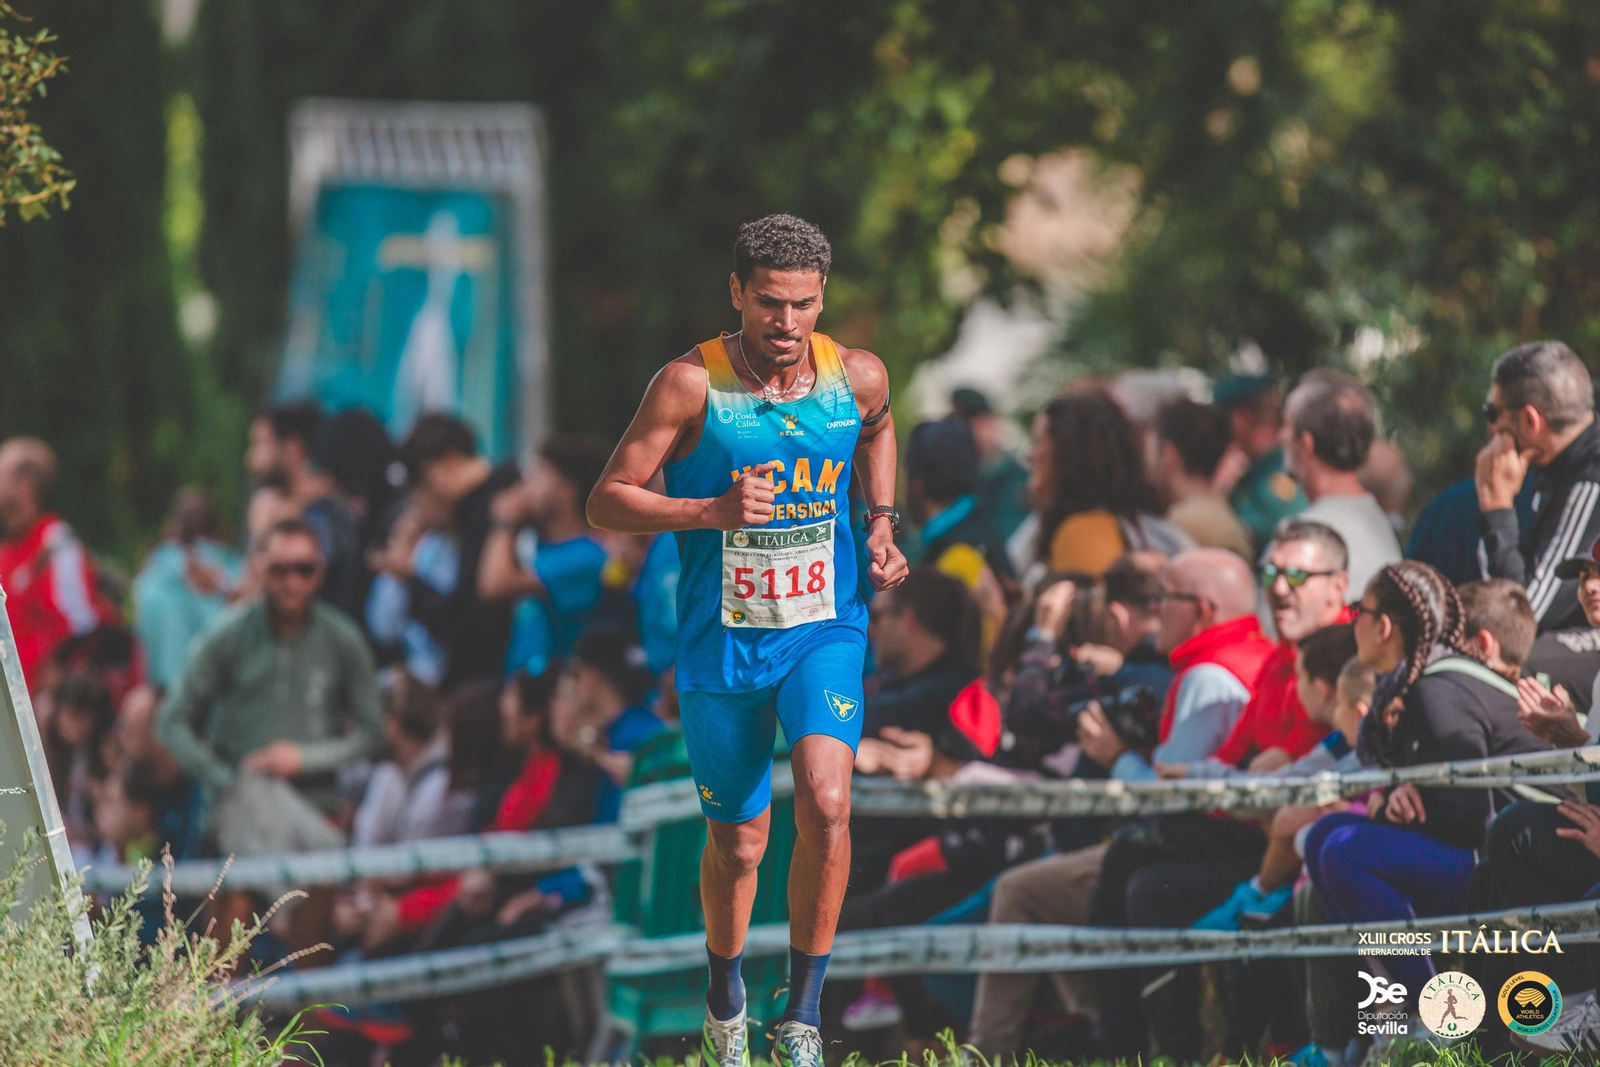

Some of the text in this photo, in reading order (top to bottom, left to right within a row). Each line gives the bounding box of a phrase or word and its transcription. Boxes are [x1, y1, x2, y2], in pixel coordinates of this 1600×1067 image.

[735, 412, 757, 420] Costa
[735, 419, 761, 428] Cálida
[826, 419, 857, 429] CARTAGENA
[757, 531, 809, 547] ITÁLICA
[733, 560, 826, 600] 5118
